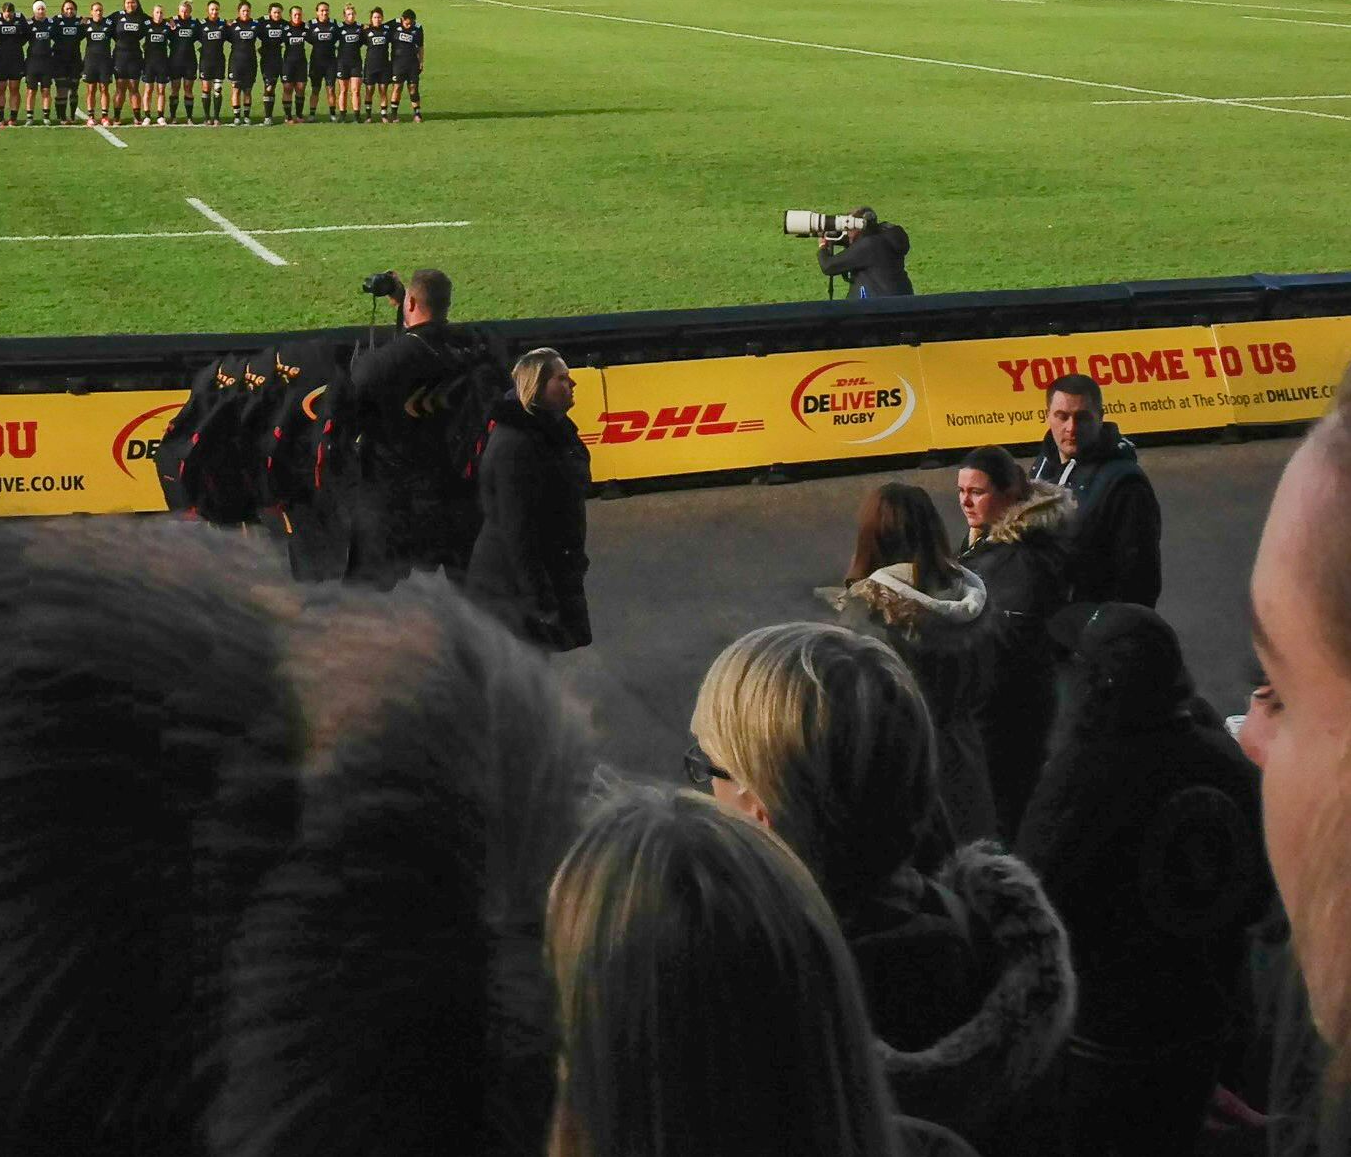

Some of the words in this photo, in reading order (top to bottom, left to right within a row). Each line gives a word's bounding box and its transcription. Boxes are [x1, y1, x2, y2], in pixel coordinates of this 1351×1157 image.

[1088, 349, 1189, 387] COME
[1194, 346, 1243, 379] TO
[1248, 341, 1297, 375] US
[835, 377, 868, 387] DHL
[803, 388, 902, 415] DELIVERS
[946, 410, 1005, 427] Nominate
[1007, 408, 1034, 426] your
[1130, 401, 1139, 413] a
[1141, 394, 1176, 412] match
[1179, 394, 1192, 409] at
[1193, 392, 1216, 408] The
[1253, 390, 1265, 405] at
[597, 402, 738, 444] DHL
[833, 412, 875, 426] RUGBY
